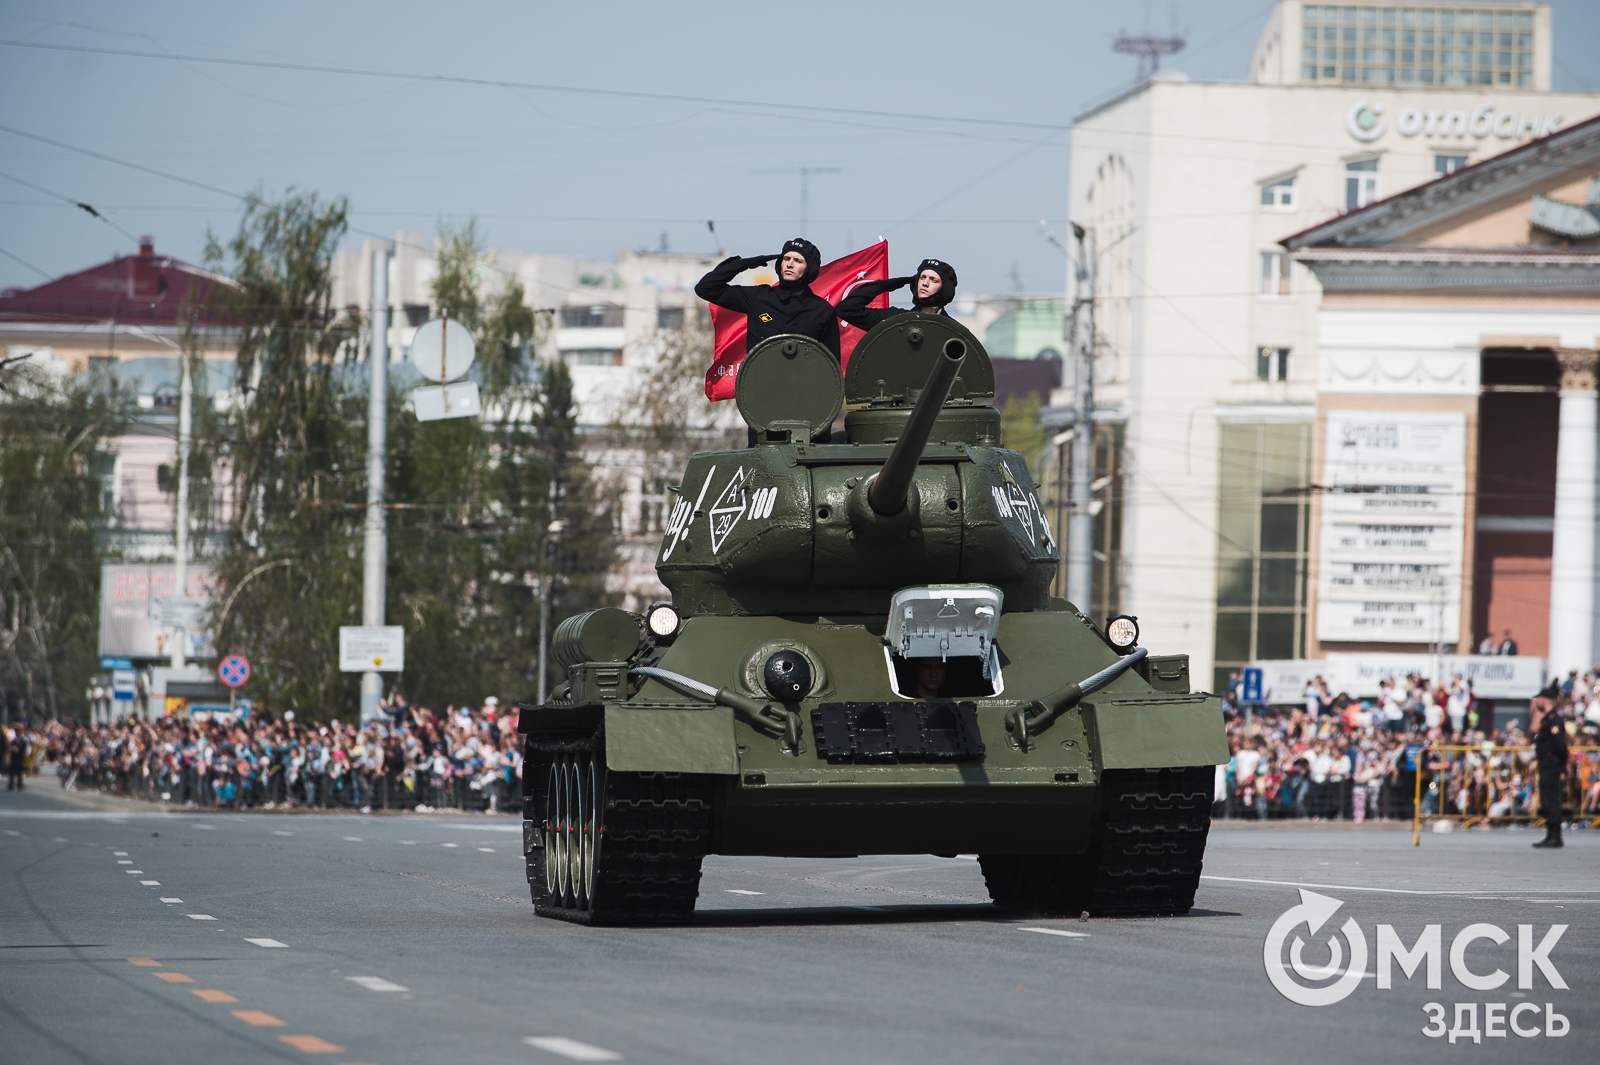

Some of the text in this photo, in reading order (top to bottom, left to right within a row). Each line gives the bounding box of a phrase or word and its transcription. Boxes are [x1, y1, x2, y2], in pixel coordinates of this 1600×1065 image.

[747, 486, 778, 521] 100
[991, 485, 1013, 518] 100
[715, 513, 732, 535] 29
